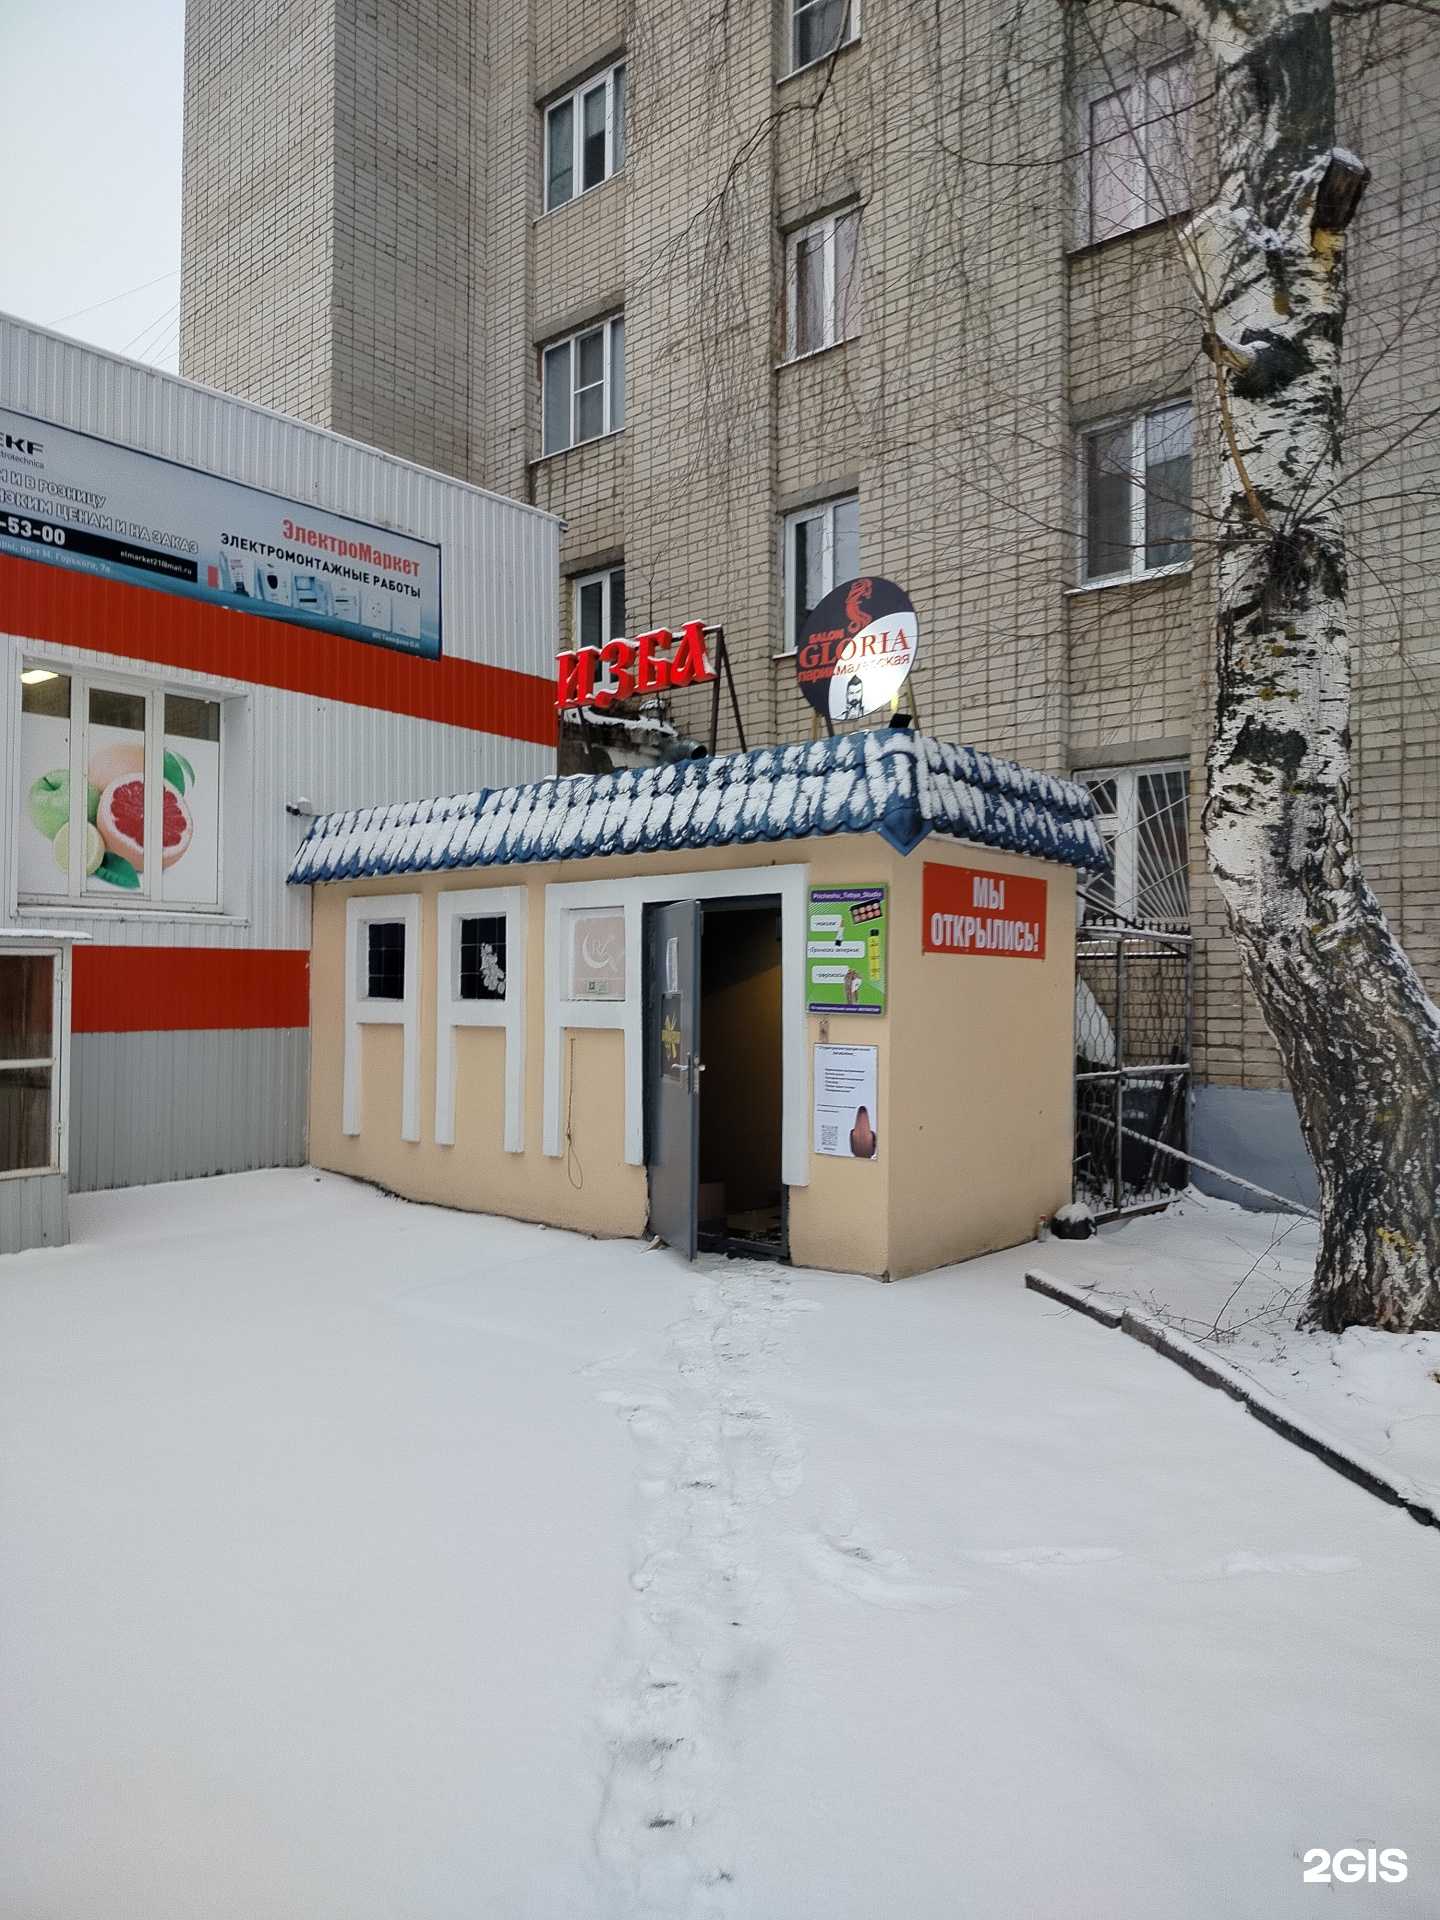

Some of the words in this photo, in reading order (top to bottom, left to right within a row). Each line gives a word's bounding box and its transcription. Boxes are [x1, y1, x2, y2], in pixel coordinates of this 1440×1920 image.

[11, 470, 22, 487] И
[24, 475, 36, 490] В
[38, 478, 106, 510] РОЗНИЦУ
[56, 503, 113, 530] ЦЕНАМ
[115, 518, 127, 536] И
[151, 530, 199, 555] ЗАКАЗ
[282, 519, 421, 577] ЭлектроМаркет
[220, 532, 370, 584] ЭЛЕКТРОМОНТАЖНЫЕ
[372, 575, 421, 600] РАБОТЫ
[553, 619, 718, 709] ИЗБА
[799, 631, 912, 669] GLORIA
[972, 876, 1005, 910] МЫ
[931, 912, 1040, 952] ОТКРЫЛИСЬ!
